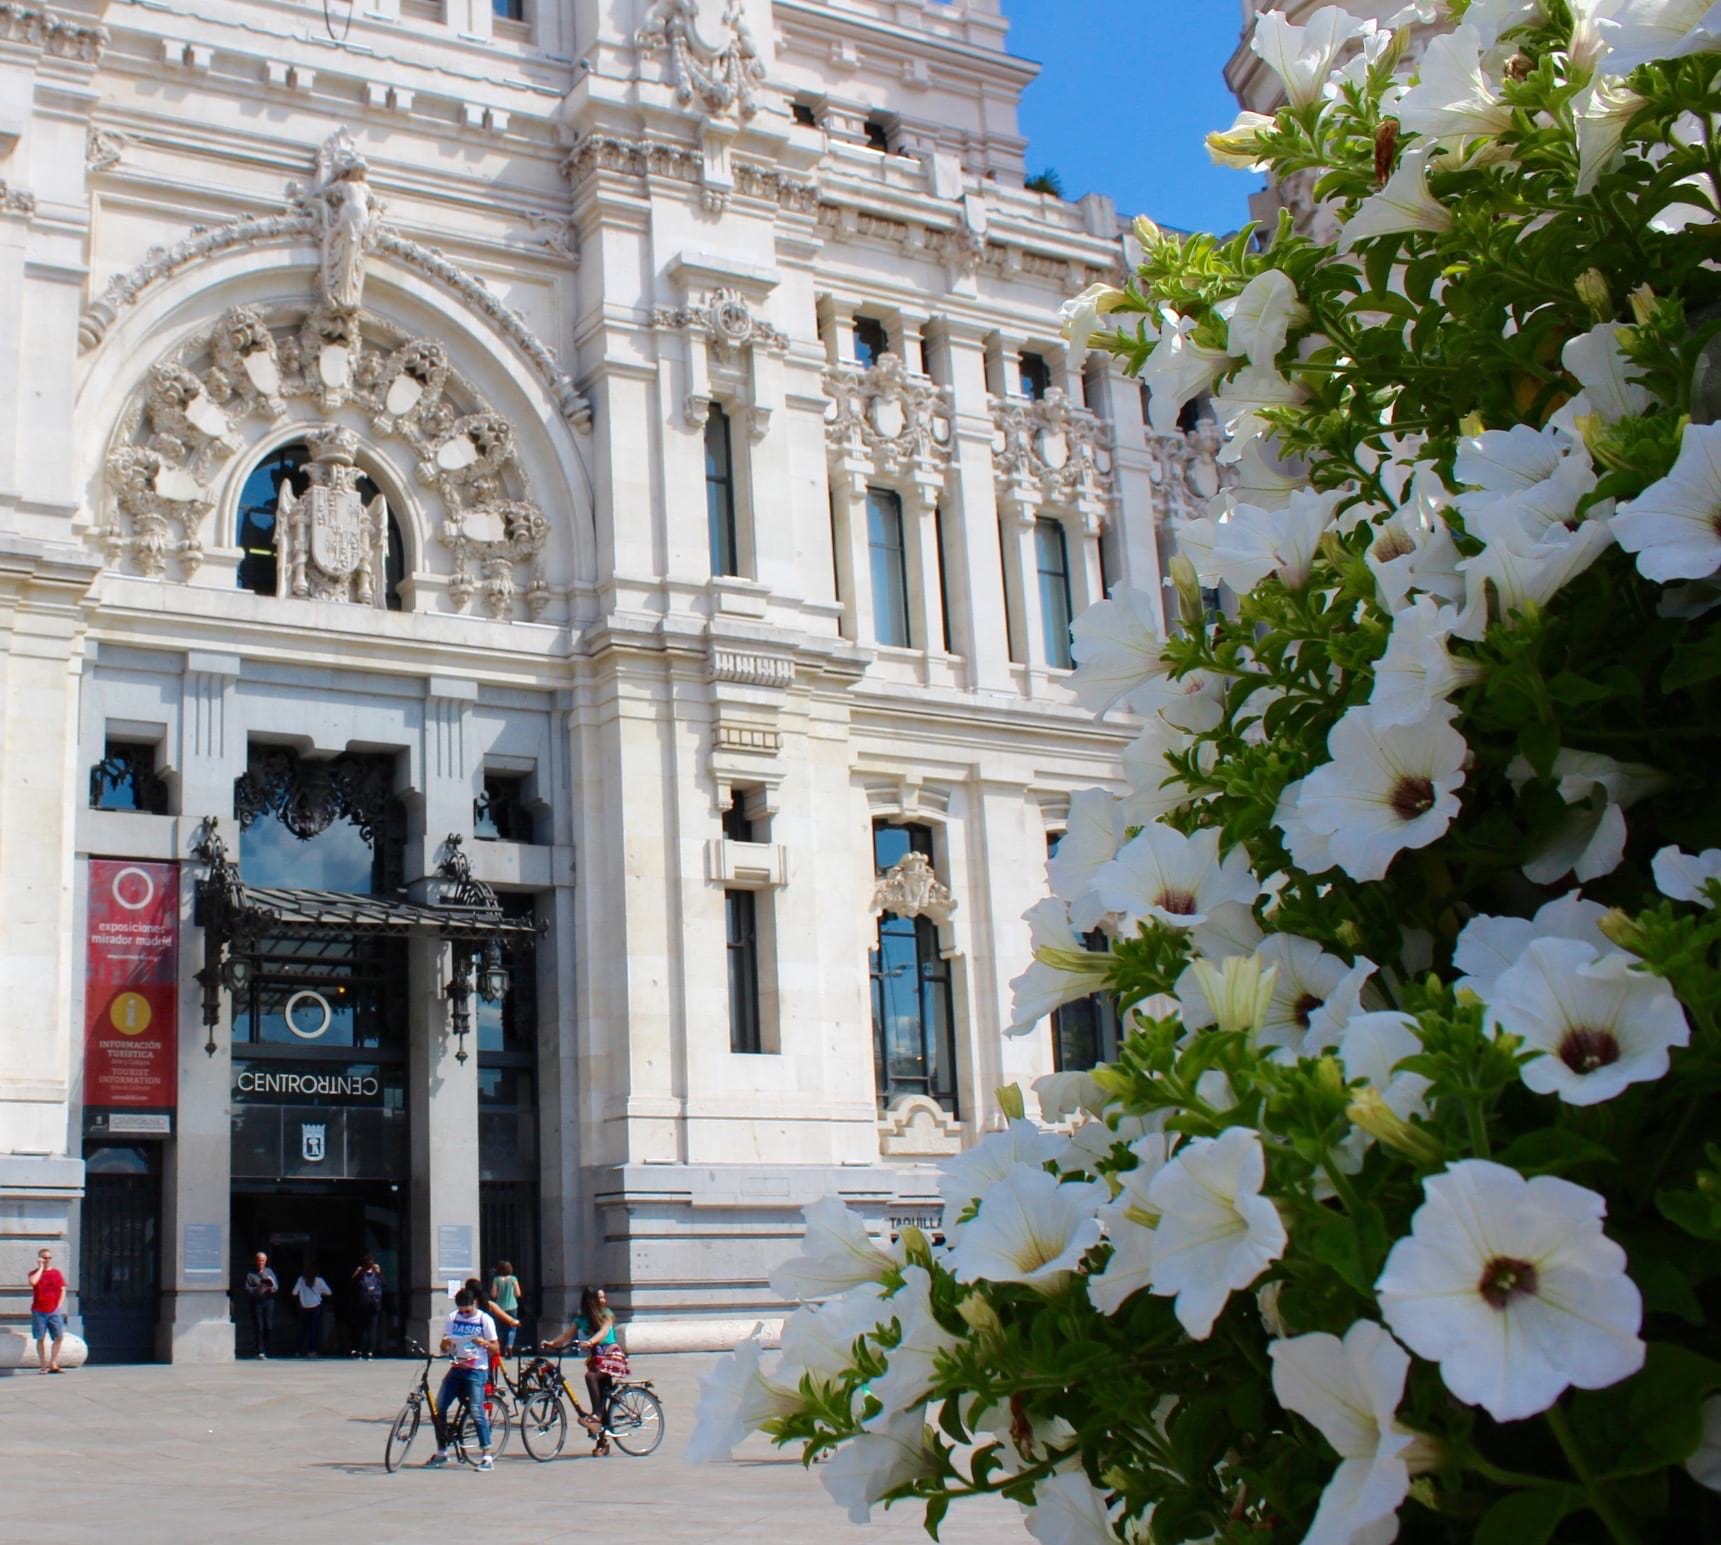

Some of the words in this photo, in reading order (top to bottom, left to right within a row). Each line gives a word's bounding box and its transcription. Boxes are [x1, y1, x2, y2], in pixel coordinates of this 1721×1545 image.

[98, 921, 165, 933] exposiciones
[91, 933, 133, 945] mirador
[136, 935, 172, 947] madrid
[99, 1039, 162, 1049] INFORMACIÓN
[107, 1049, 154, 1059] TURÍSTICA
[111, 1067, 150, 1076] TOURIST
[98, 1075, 161, 1085] INFORMATION
